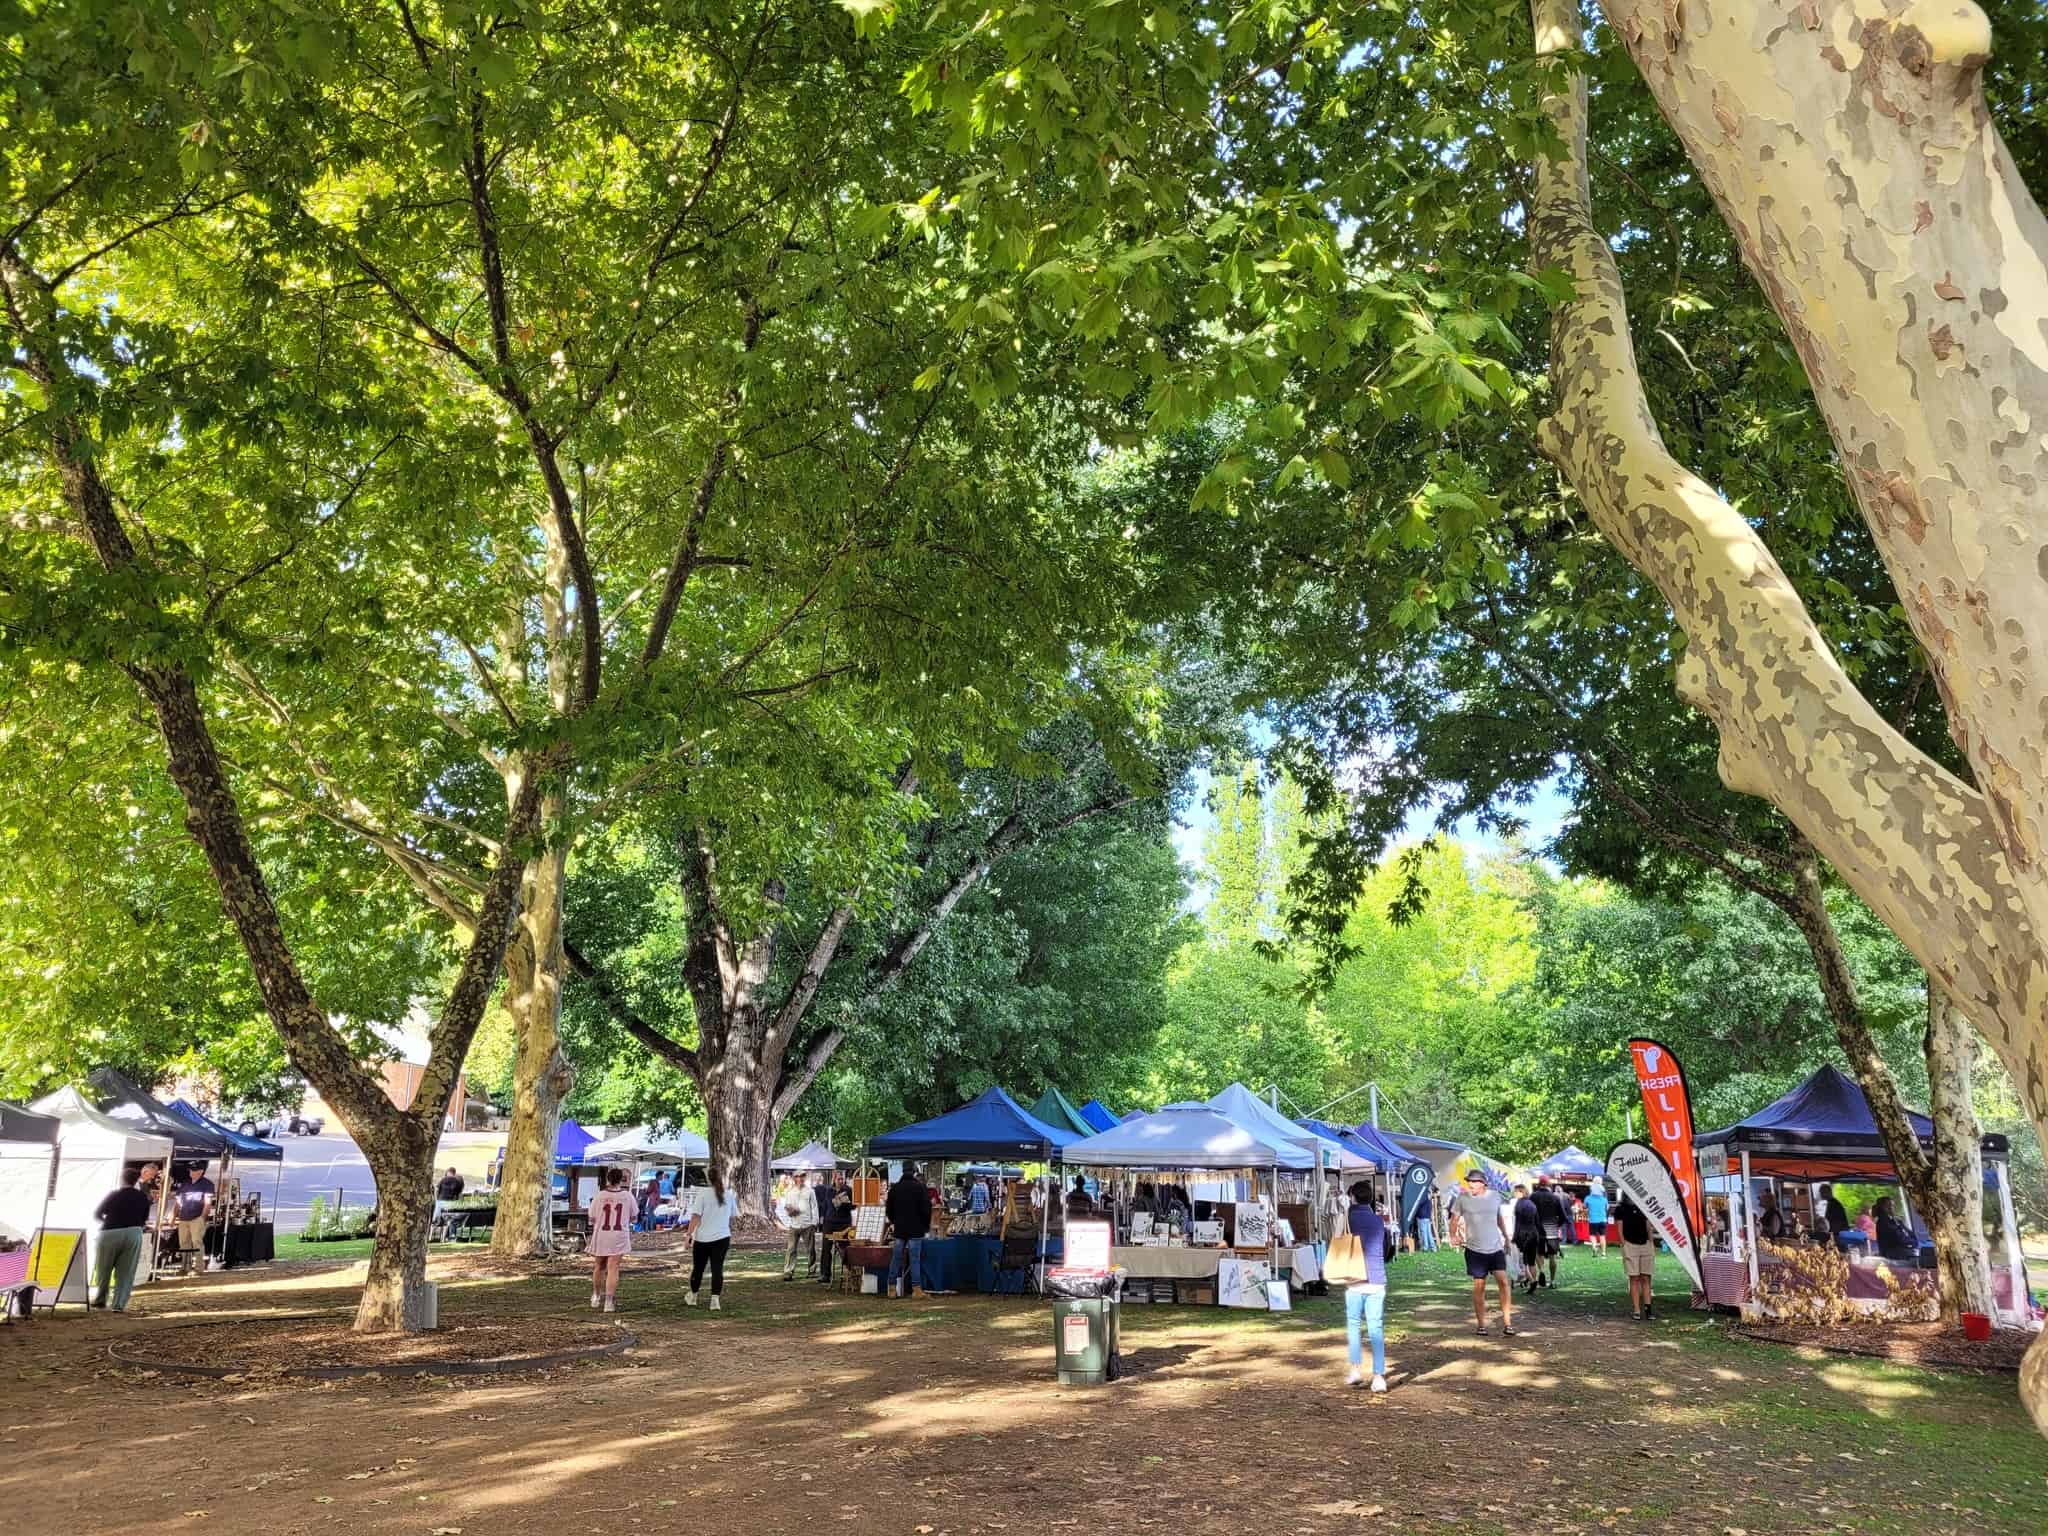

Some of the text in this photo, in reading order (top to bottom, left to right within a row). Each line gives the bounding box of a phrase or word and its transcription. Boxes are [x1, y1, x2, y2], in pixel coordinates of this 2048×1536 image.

[602, 1203, 623, 1231] 11
[1622, 1170, 1688, 1248] Italian Style Donuts
